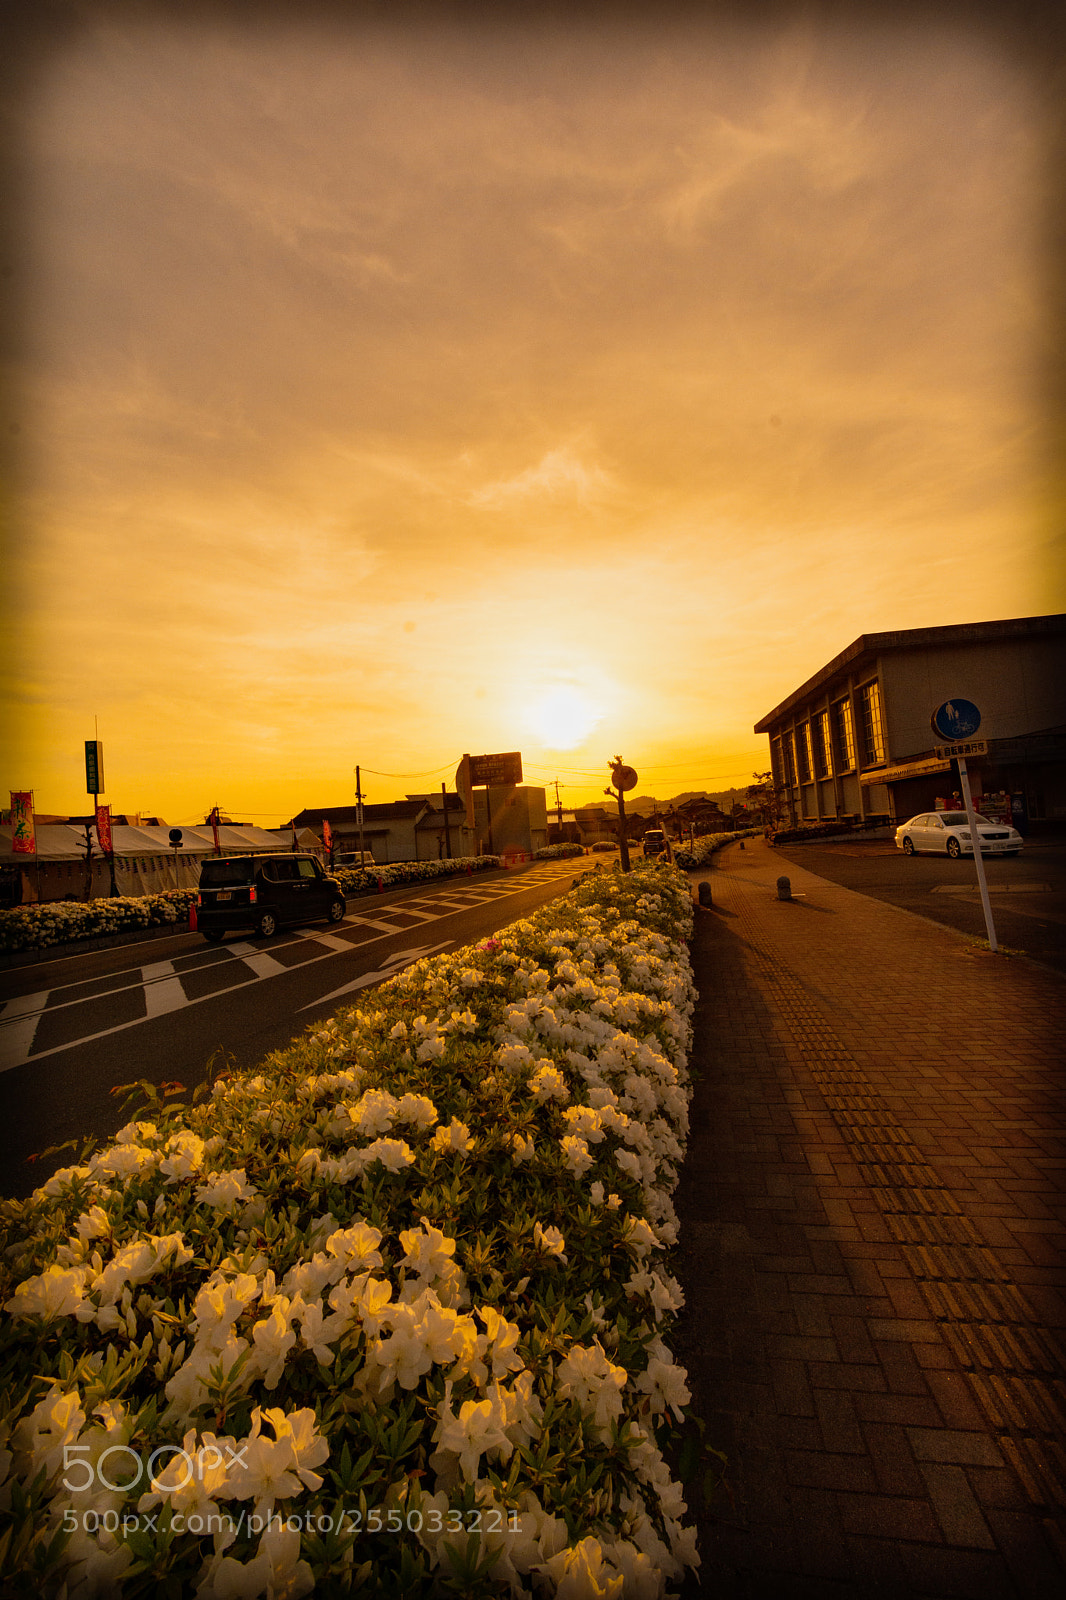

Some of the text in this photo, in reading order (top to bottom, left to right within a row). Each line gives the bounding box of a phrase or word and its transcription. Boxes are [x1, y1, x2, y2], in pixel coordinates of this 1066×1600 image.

[944, 742, 985, 756] 自転車通行可
